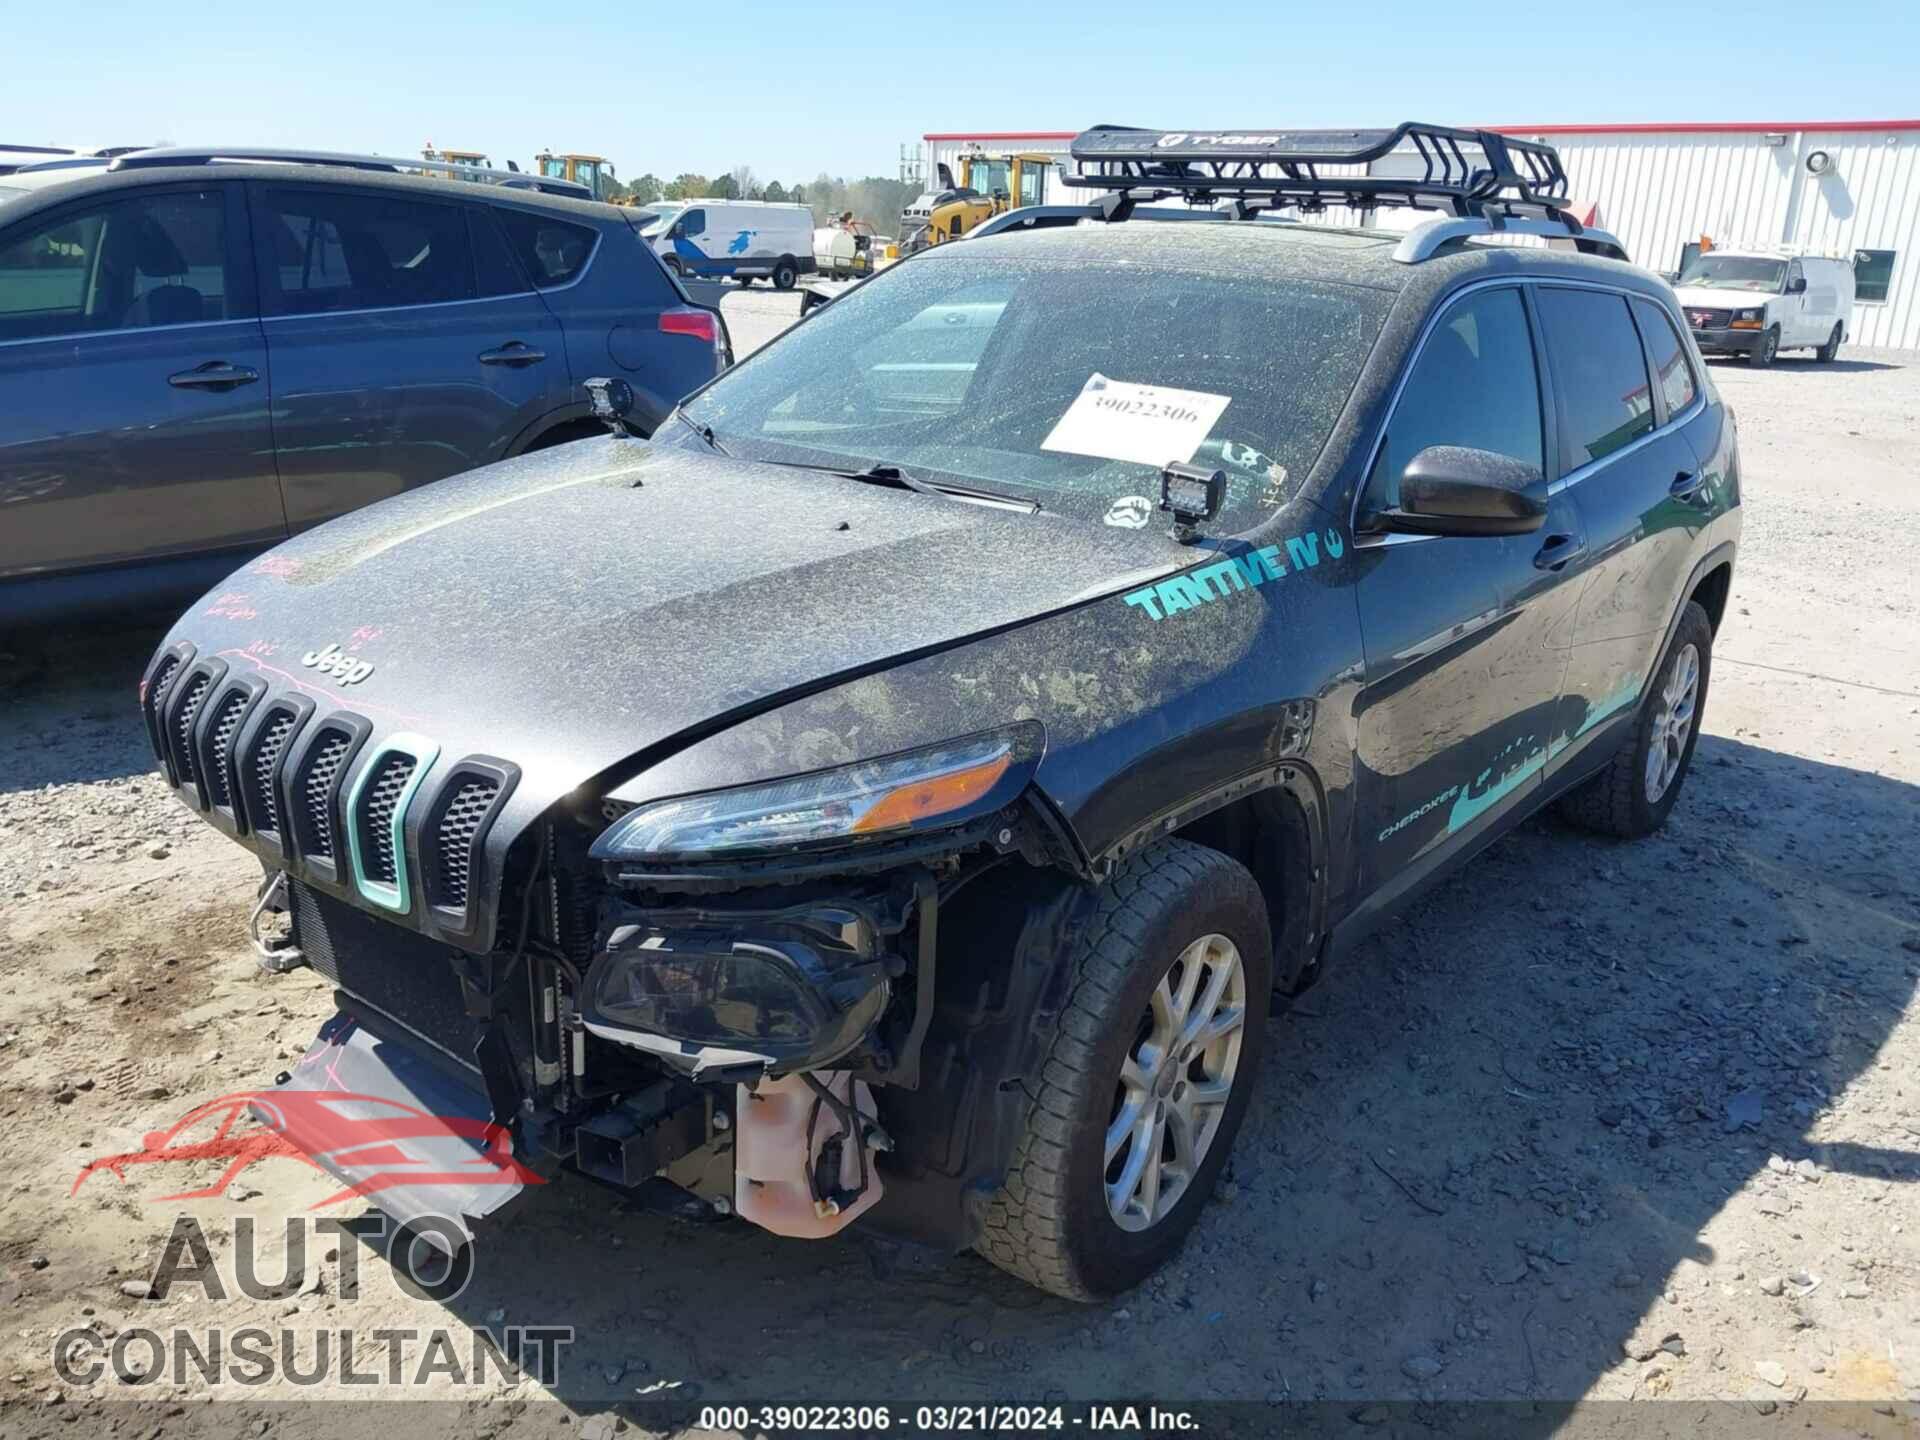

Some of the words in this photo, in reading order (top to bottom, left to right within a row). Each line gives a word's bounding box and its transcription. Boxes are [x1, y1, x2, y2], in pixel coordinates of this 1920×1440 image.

[1191, 135, 1280, 145] TYGER
[1123, 543, 1288, 622] TANTIVE
[1285, 531, 1320, 571] IV
[301, 642, 375, 688] Jeep
[1378, 784, 1460, 843] CHEROKEE
